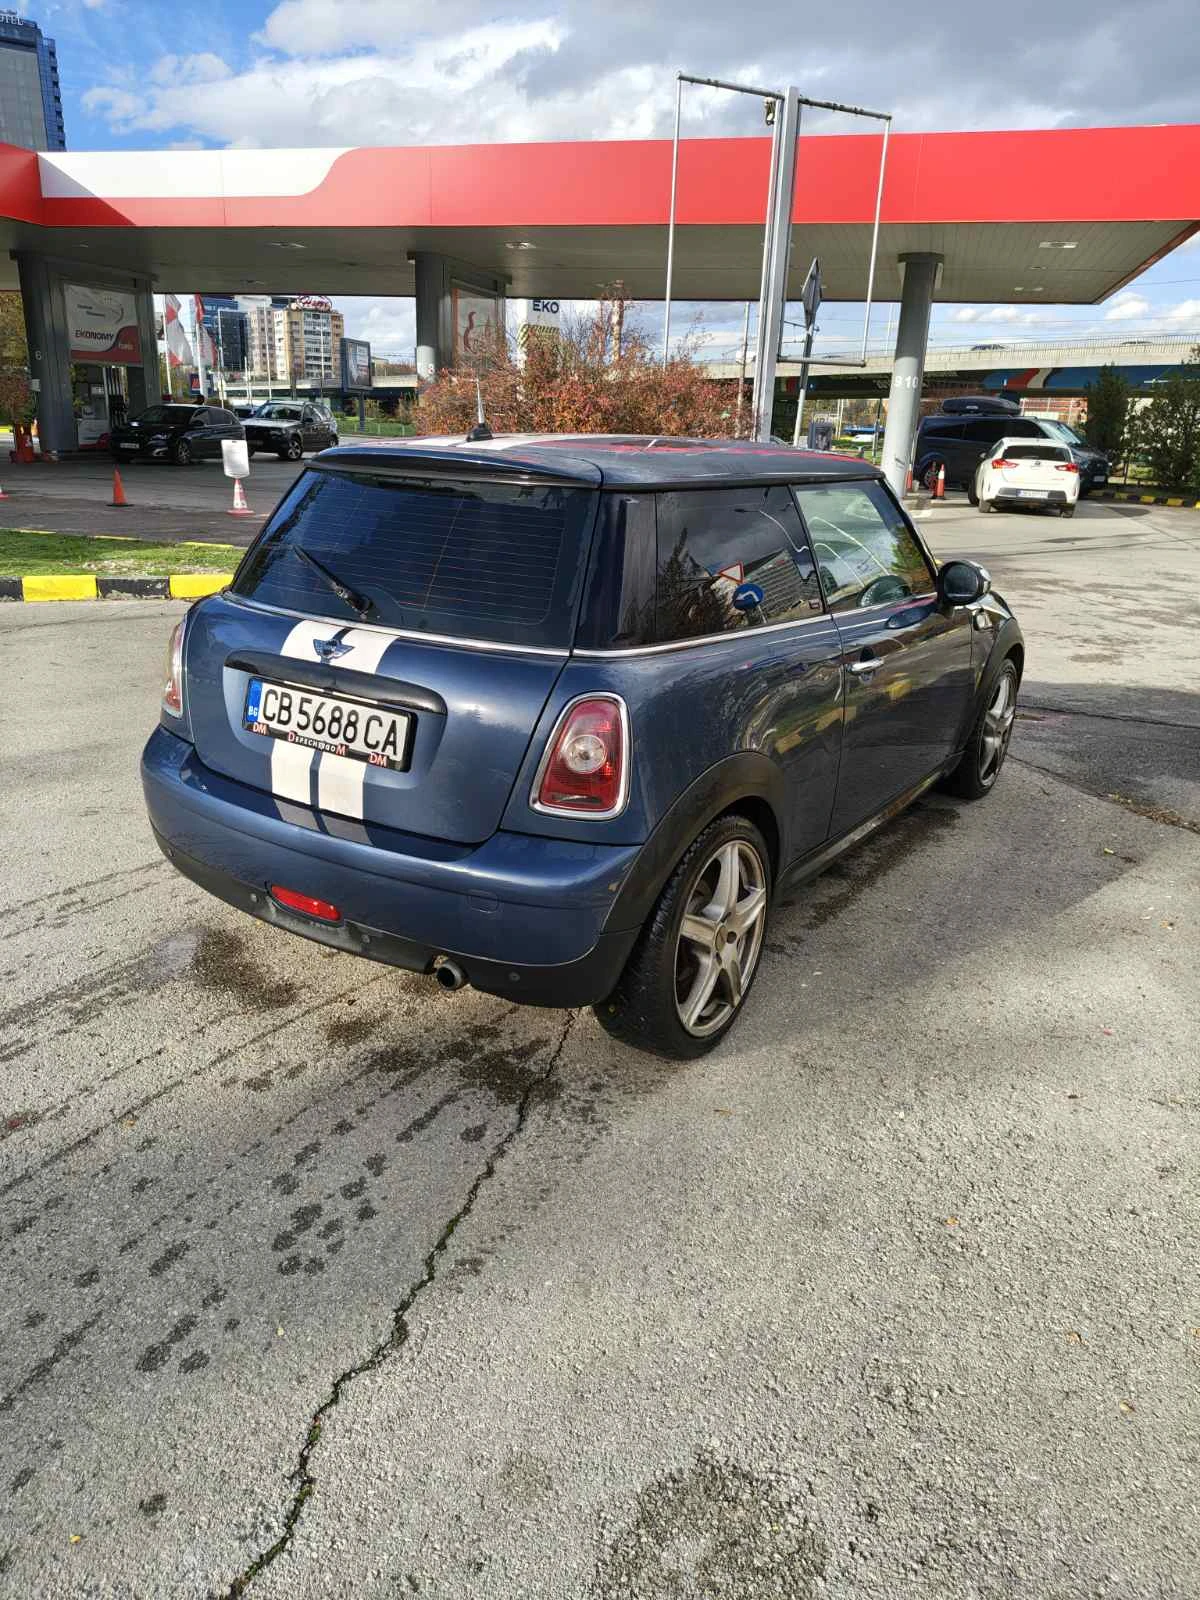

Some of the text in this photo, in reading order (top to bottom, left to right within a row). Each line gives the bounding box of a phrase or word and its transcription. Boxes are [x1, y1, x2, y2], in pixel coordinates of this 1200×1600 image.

[532, 299, 560, 314] EKO
[75, 329, 114, 341] EKONOMY
[35, 350, 42, 361] 6
[248, 705, 259, 717] BG
[263, 688, 398, 756] CB 5688 CA
[252, 723, 267, 736] DM
[368, 752, 388, 767] DM
